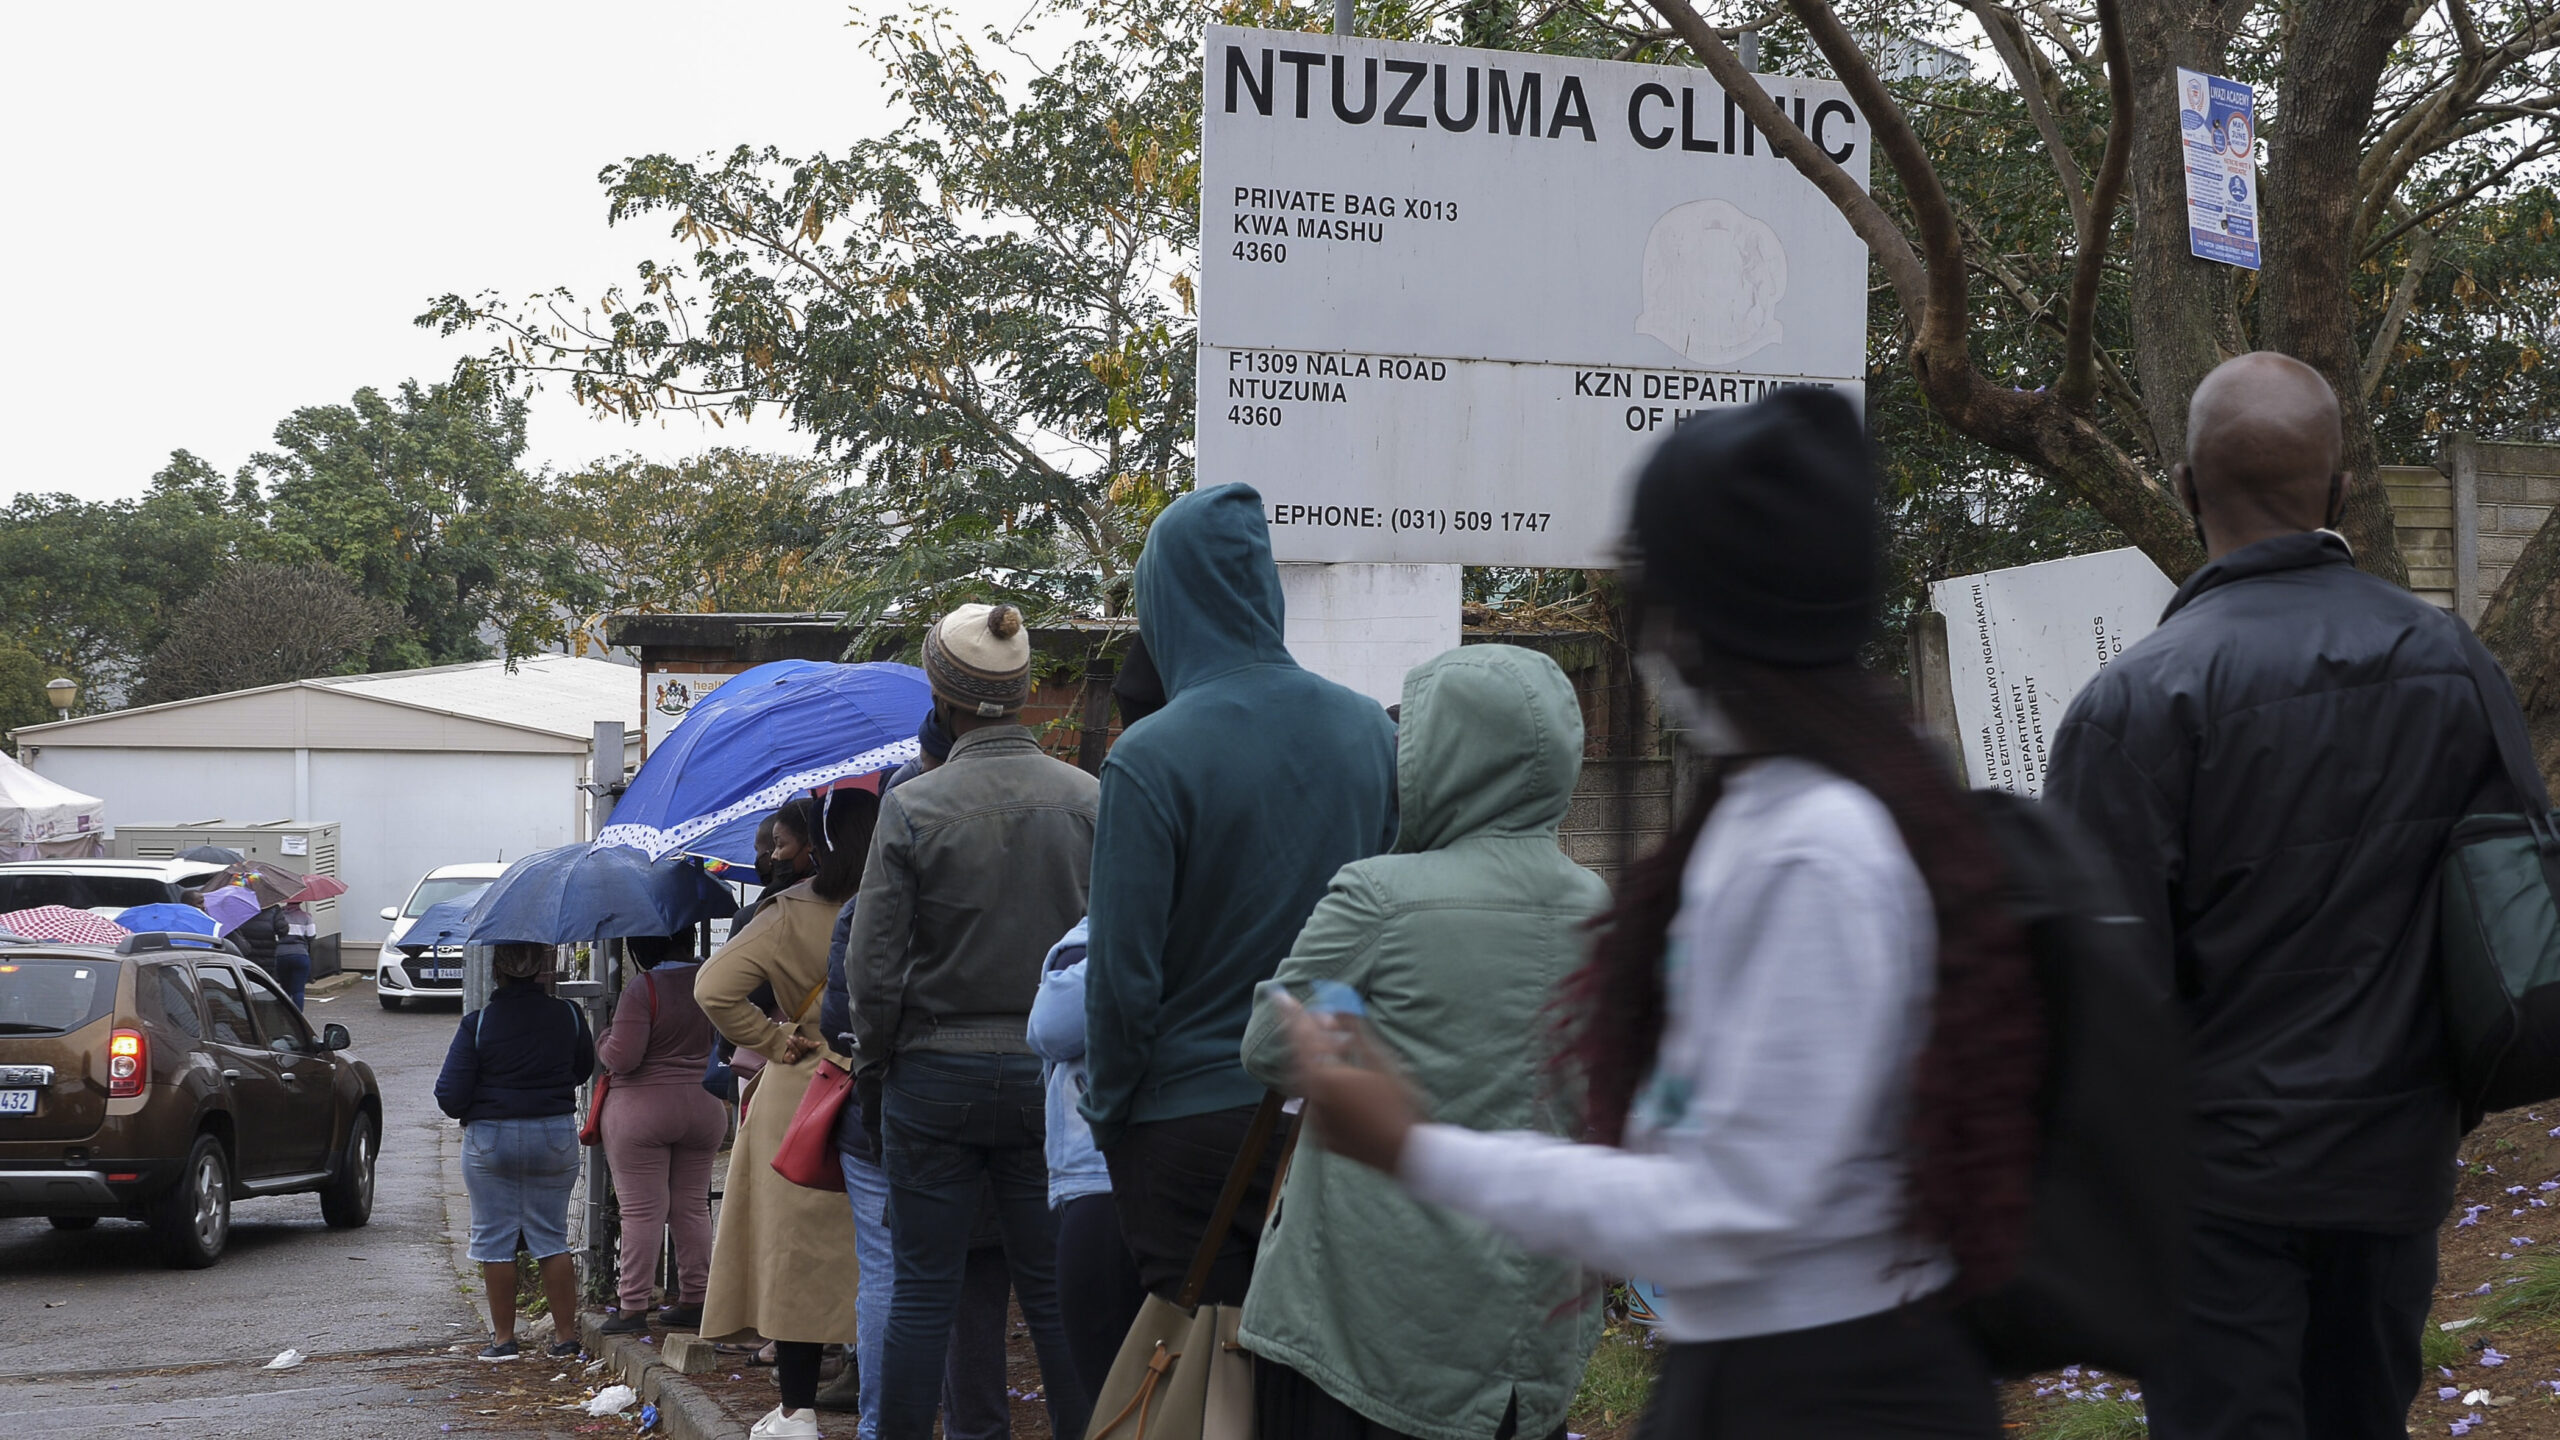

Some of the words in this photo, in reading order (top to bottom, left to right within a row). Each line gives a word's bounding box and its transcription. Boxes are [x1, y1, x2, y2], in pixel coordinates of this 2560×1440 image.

[1225, 45, 1597, 142] NTUZUMA
[2226, 89, 2250, 107] ACADEMY
[1234, 187, 1335, 213] PRIVATE
[1344, 194, 1396, 217] BAG
[1404, 199, 1458, 222] X013
[1234, 213, 1289, 237] KWA
[1297, 218, 1383, 243] MASHU
[1232, 241, 1287, 263] 4360
[1229, 351, 1298, 374] F1309
[1306, 355, 1371, 378] NALA
[1378, 359, 1447, 382] ROAD
[1229, 378, 1347, 403] NTUZUMA
[1575, 371, 1631, 398] KZN
[1643, 374, 1834, 404] DEPARTM
[1228, 405, 1282, 427] 4360
[1626, 406, 1664, 431] OF
[1391, 508, 1447, 535] (031)
[1453, 511, 1493, 532] 509
[1500, 511, 1551, 532] 1747
[1971, 584, 1994, 664] NGAPHAKATHI
[1986, 667, 2010, 766] EZITHOLAKALAYO
[2025, 675, 2048, 773] DEPARTMENT
[2011, 684, 2035, 782] DEPARTMENT
[1981, 726, 1998, 781] NTUZUMA
[1, 1092, 29, 1109] 432
